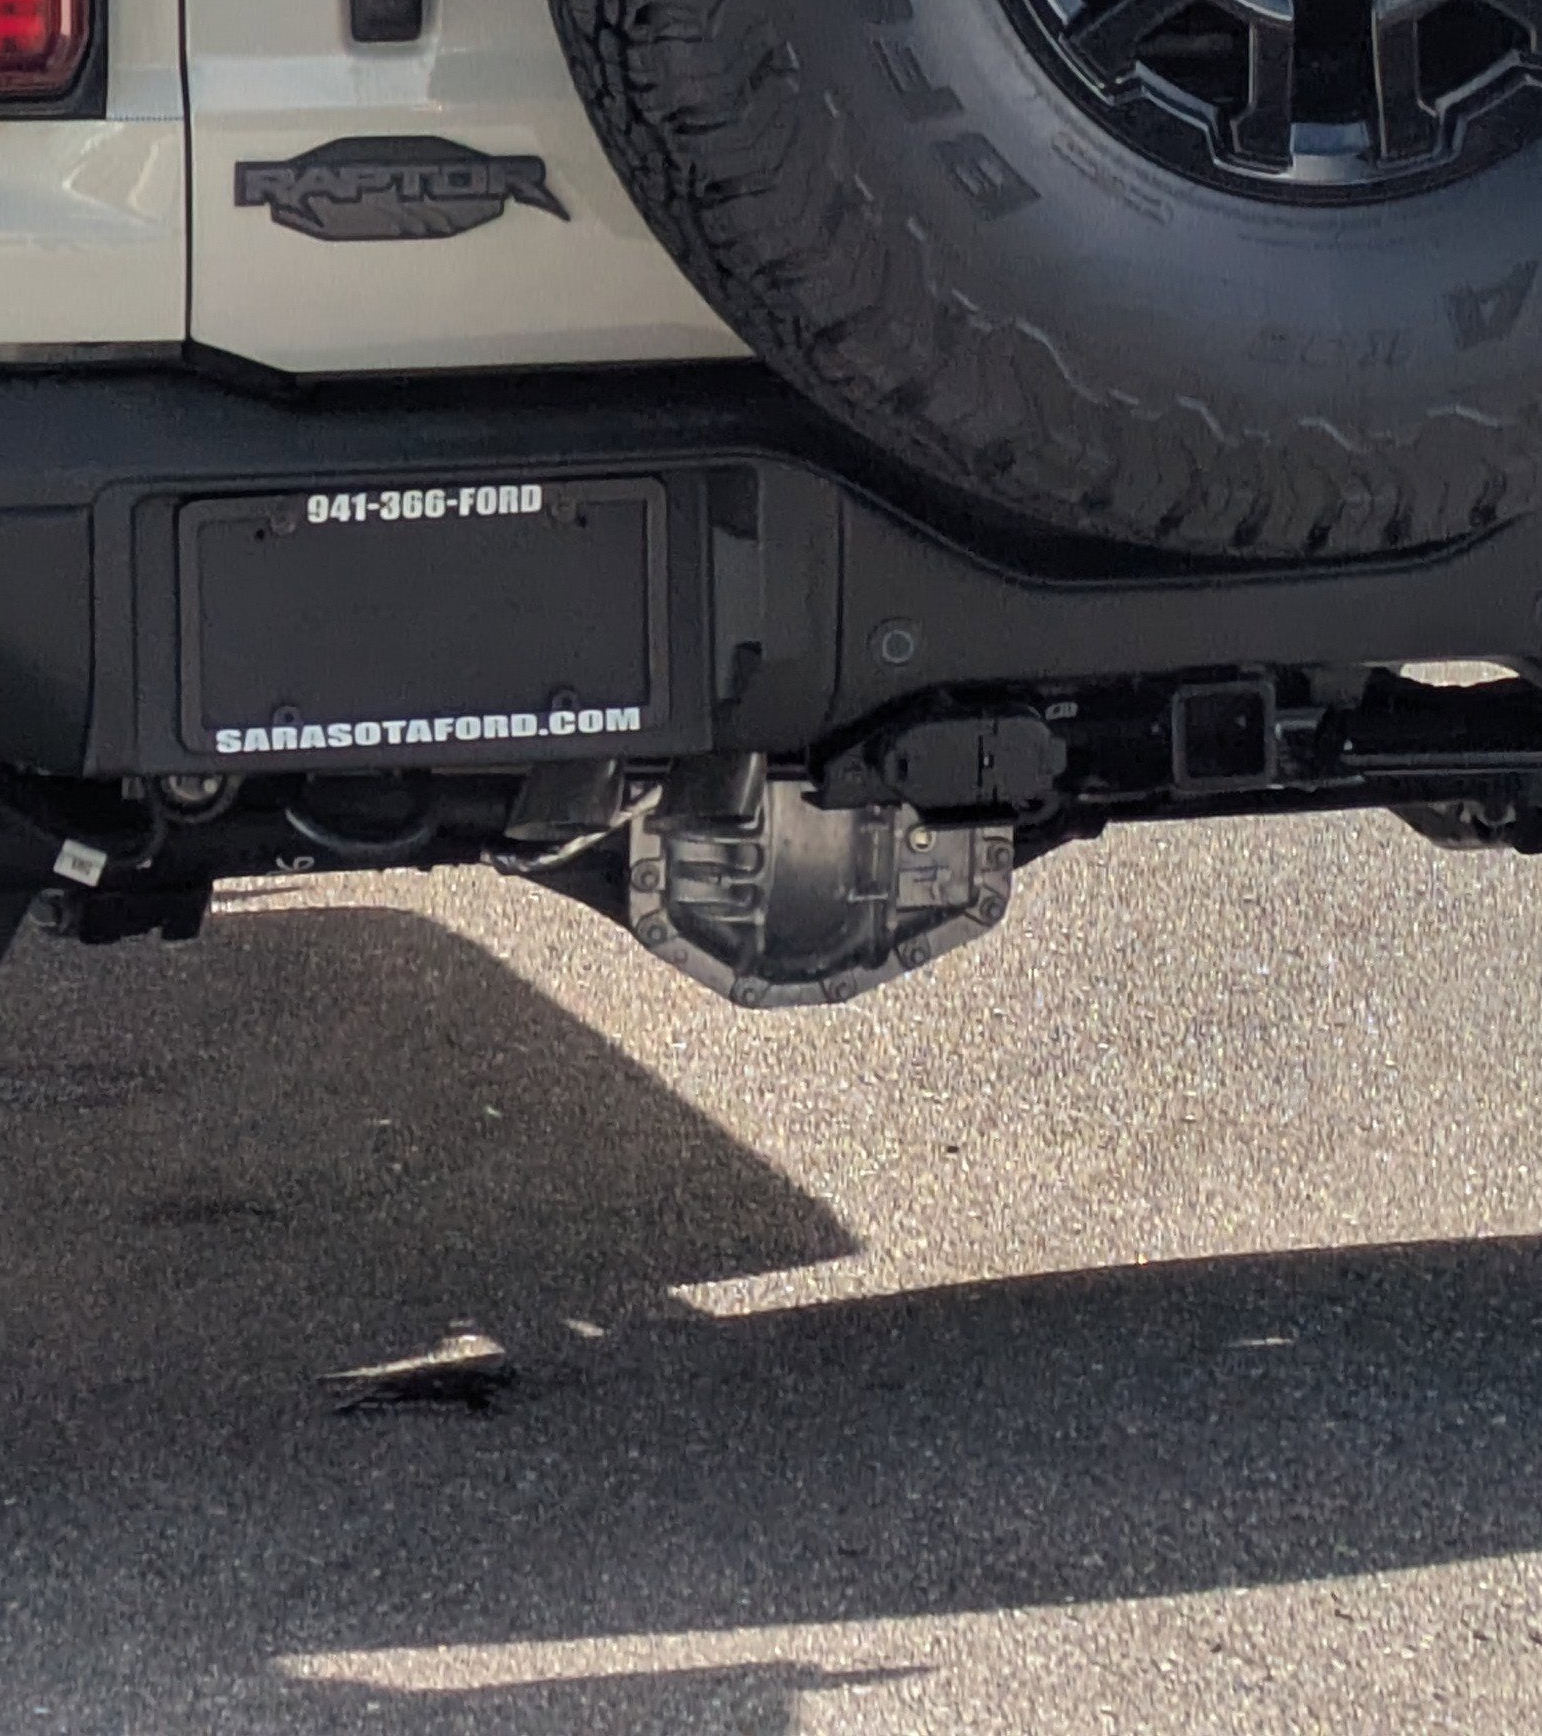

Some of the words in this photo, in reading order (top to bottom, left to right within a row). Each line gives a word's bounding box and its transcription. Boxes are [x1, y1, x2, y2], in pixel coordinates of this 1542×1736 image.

[234, 156, 571, 228] RAPTOR
[306, 484, 543, 524] 941-366-FORD
[215, 706, 641, 755] SARASOTAFORD.COM
